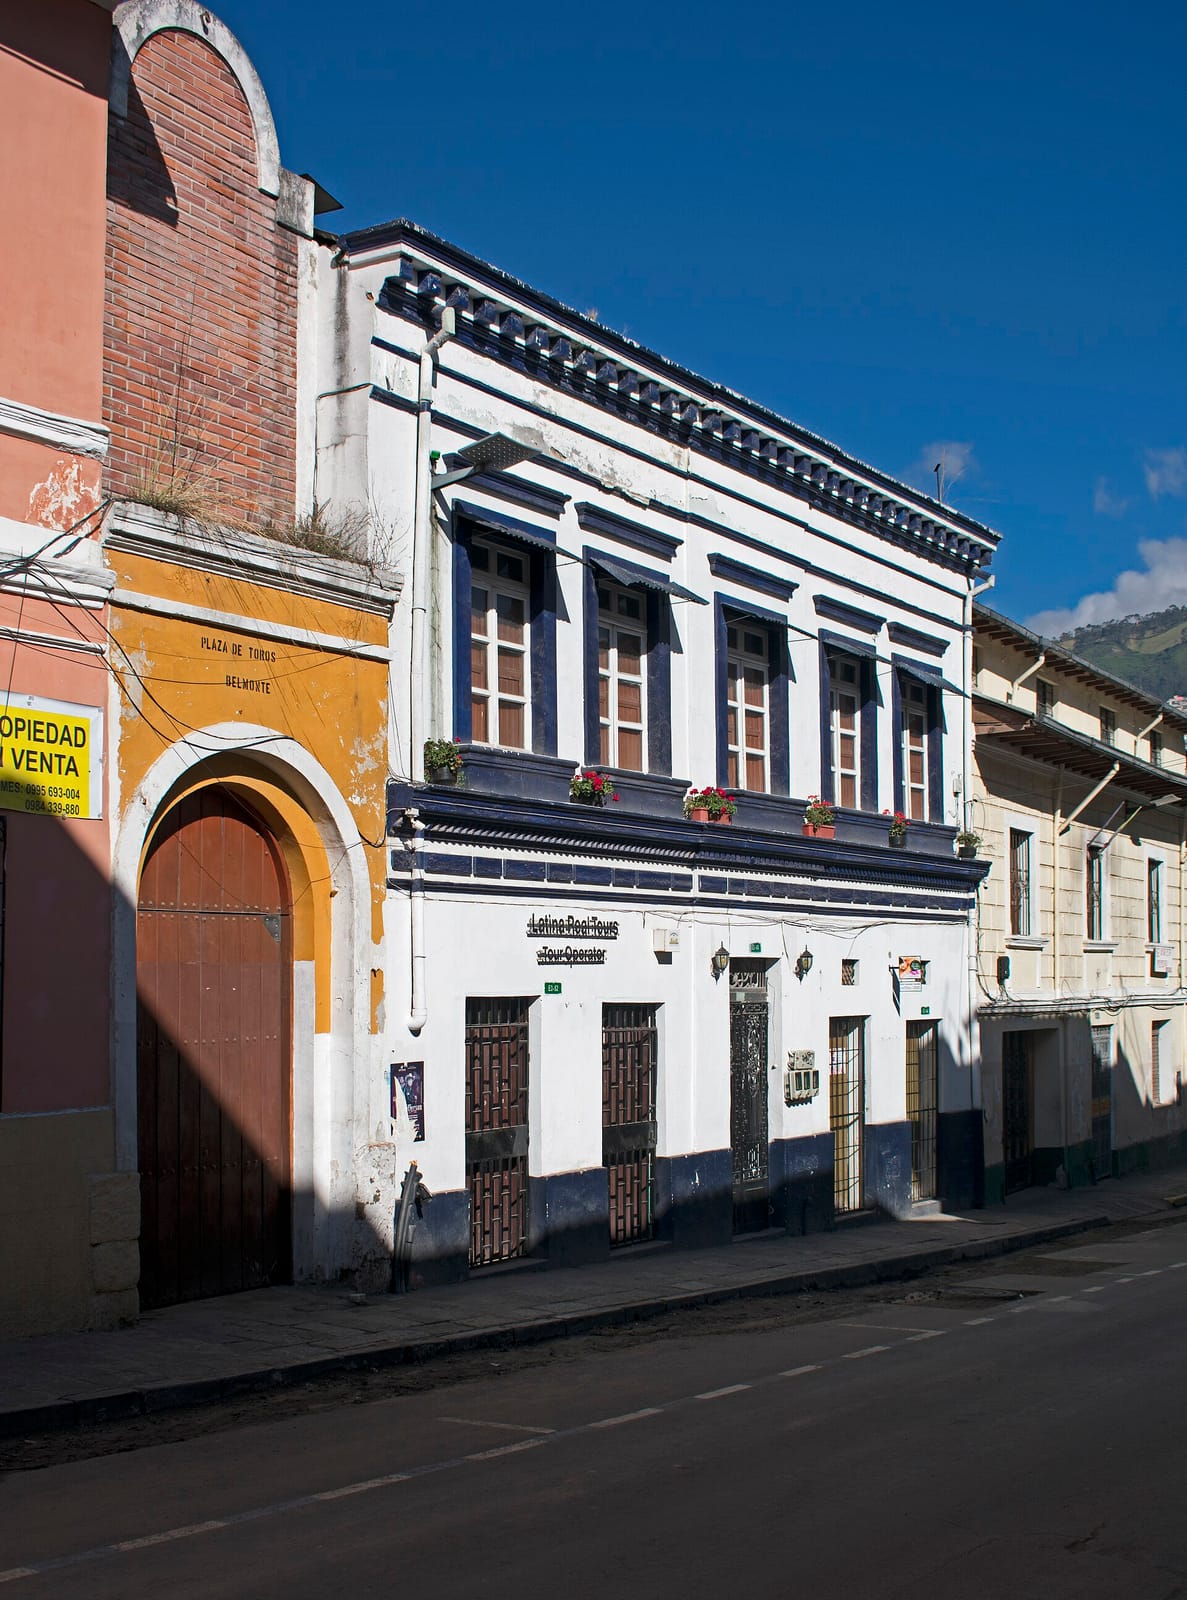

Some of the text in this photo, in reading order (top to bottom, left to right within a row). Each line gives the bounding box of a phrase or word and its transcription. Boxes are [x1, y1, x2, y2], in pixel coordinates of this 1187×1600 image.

[201, 636, 276, 662] PLAZA DE TOROS
[225, 674, 271, 694] BELMONTE
[0, 716, 86, 748] OPIEDAD
[11, 747, 79, 777] VENTA
[26, 783, 46, 796] 0995
[48, 786, 80, 800] 693-004
[25, 800, 80, 815] 0984 339-880
[591, 916, 619, 937] Tours
[542, 946, 606, 968] Tour Operator
